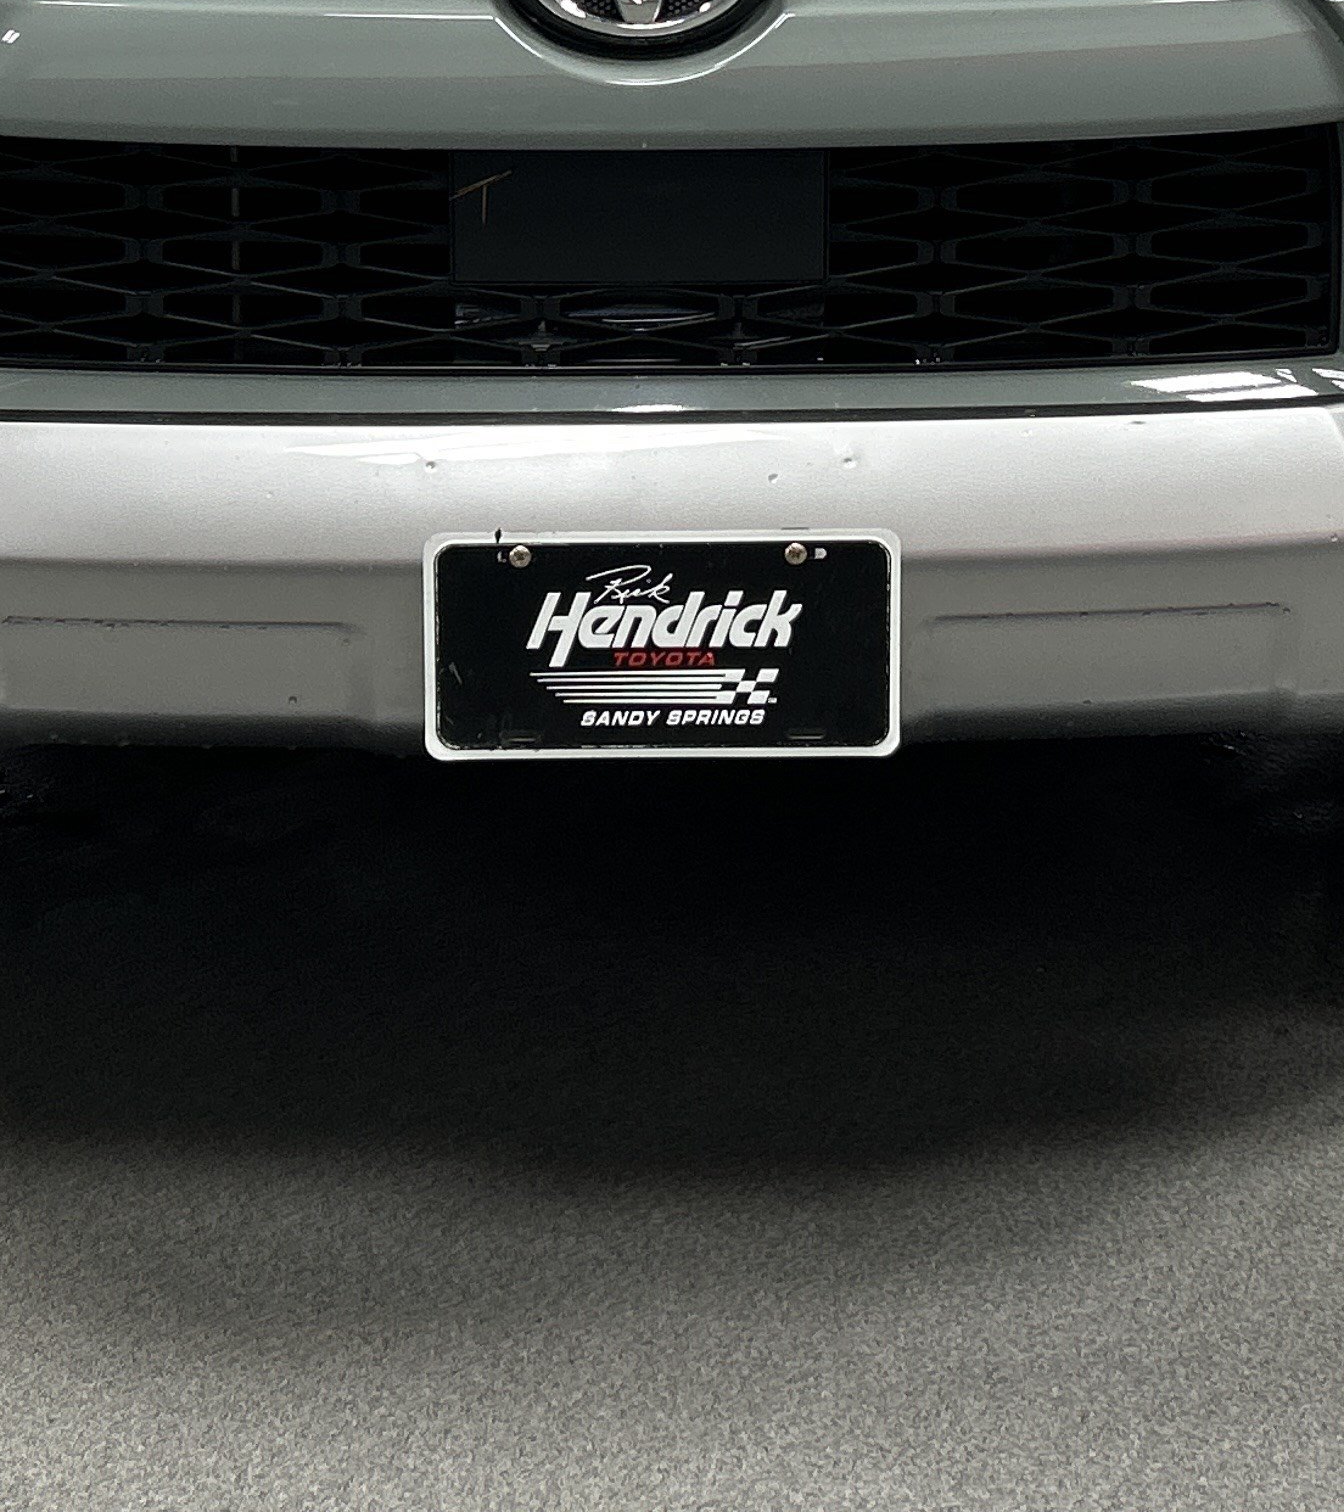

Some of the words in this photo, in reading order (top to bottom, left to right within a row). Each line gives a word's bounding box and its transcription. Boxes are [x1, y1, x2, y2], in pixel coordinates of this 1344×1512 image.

[525, 589, 803, 668] Hendrick
[613, 651, 716, 667] TOYOTA
[580, 709, 661, 727] SANDY
[666, 709, 766, 727] SPRINGS
